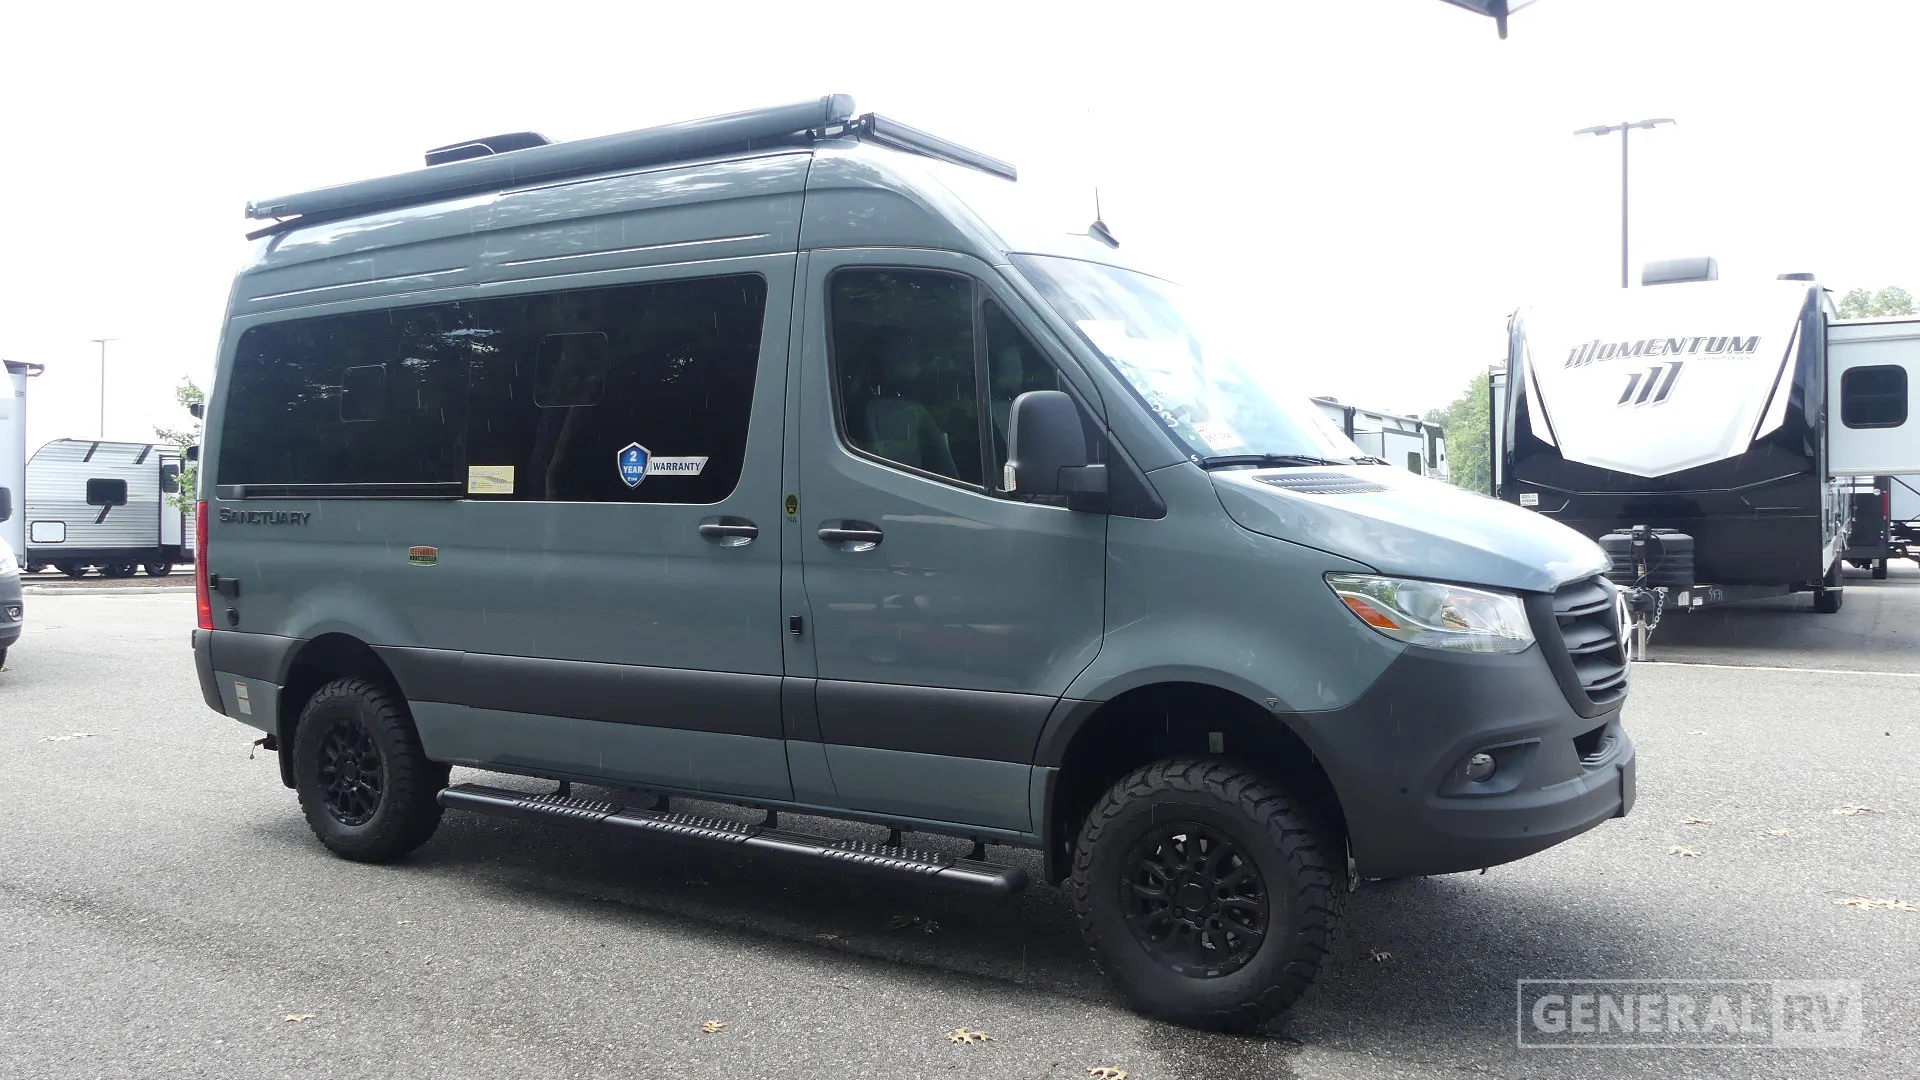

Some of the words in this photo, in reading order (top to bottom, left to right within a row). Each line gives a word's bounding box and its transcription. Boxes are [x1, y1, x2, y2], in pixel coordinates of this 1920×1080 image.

[1564, 335, 1761, 369] MOMENTUM
[629, 450, 638, 462] 2
[623, 465, 643, 474] YEAR
[653, 462, 701, 471] WARRANTY
